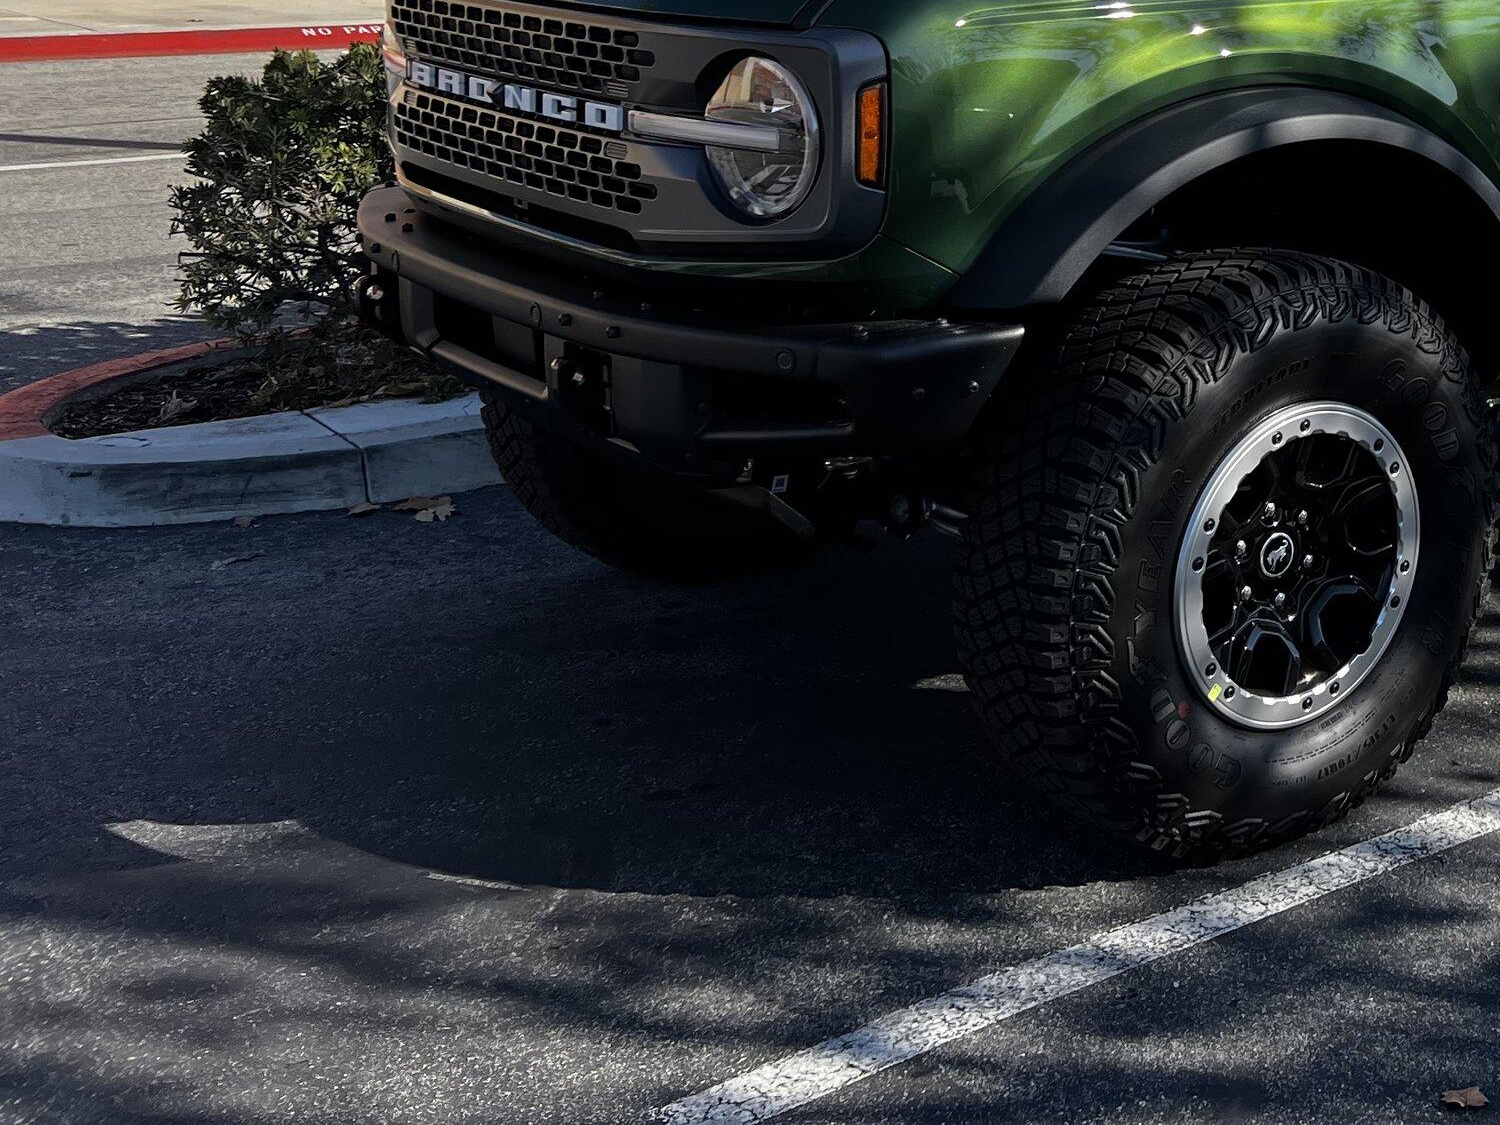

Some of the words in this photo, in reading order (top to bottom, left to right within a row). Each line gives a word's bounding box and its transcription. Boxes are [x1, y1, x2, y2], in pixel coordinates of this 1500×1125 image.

[301, 26, 333, 37] NO
[410, 61, 624, 131] BRONCO
[1124, 467, 1243, 791] GOODYEAR
